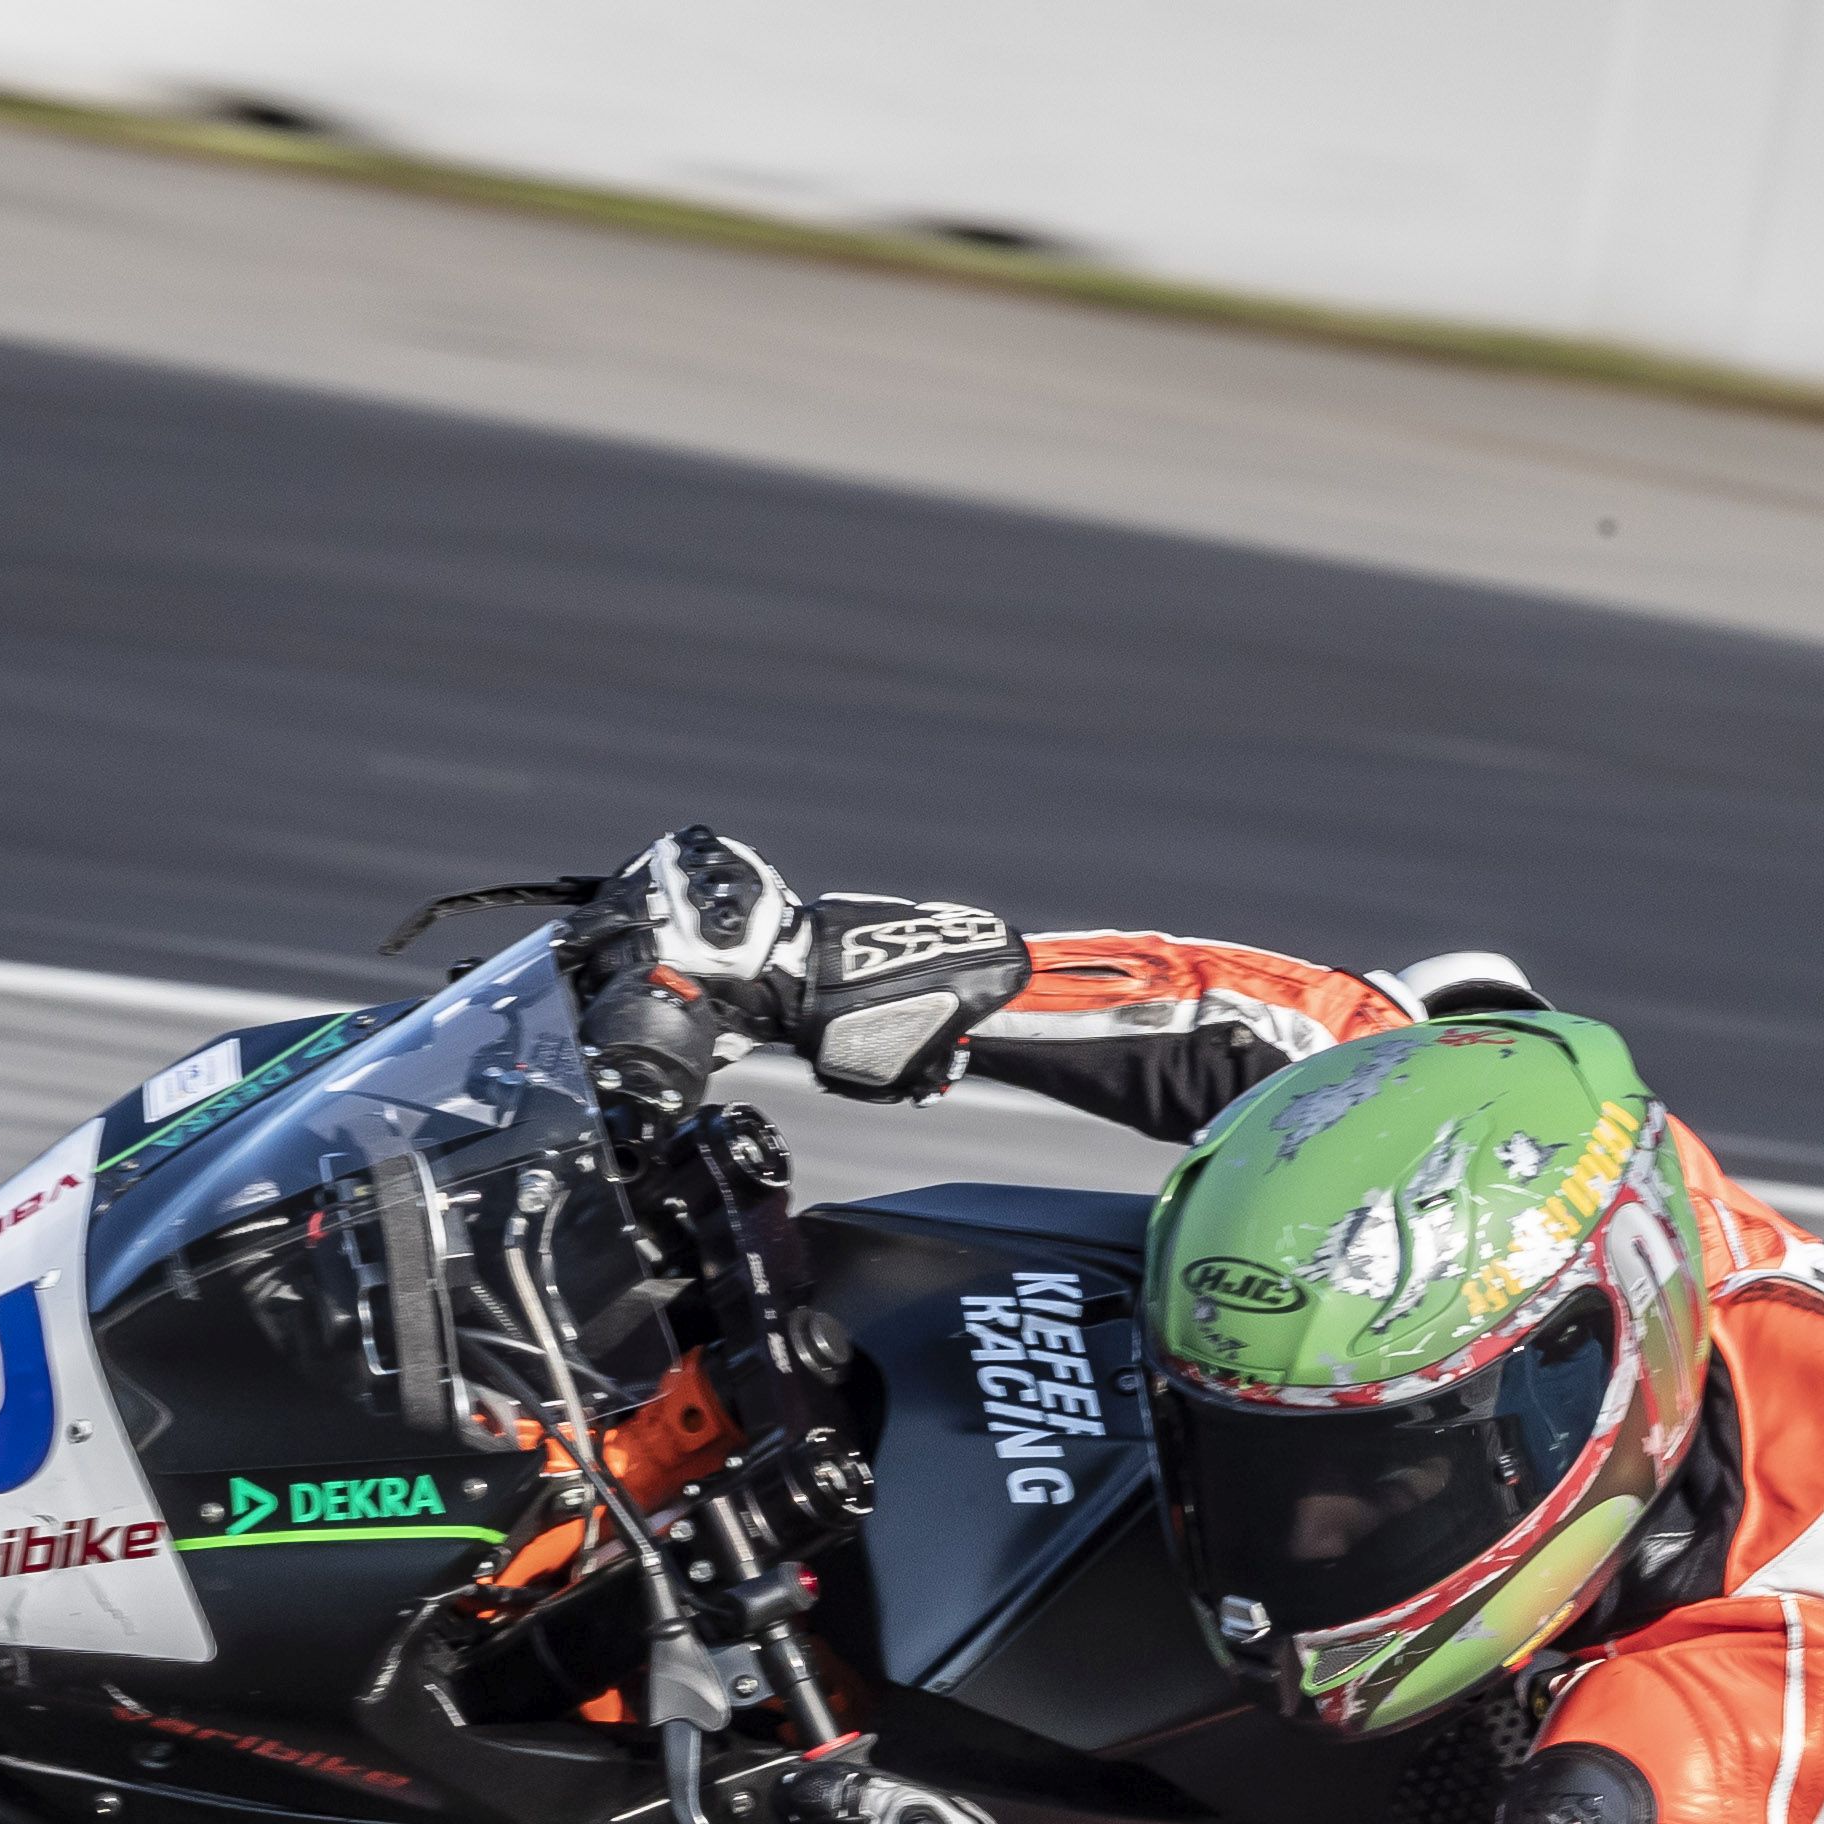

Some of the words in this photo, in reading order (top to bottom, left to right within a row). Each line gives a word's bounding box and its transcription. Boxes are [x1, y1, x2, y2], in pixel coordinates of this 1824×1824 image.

[1190, 1265, 1291, 1305] HJC
[960, 1296, 1074, 1506] RACING
[289, 1474, 446, 1524] DEKRA
